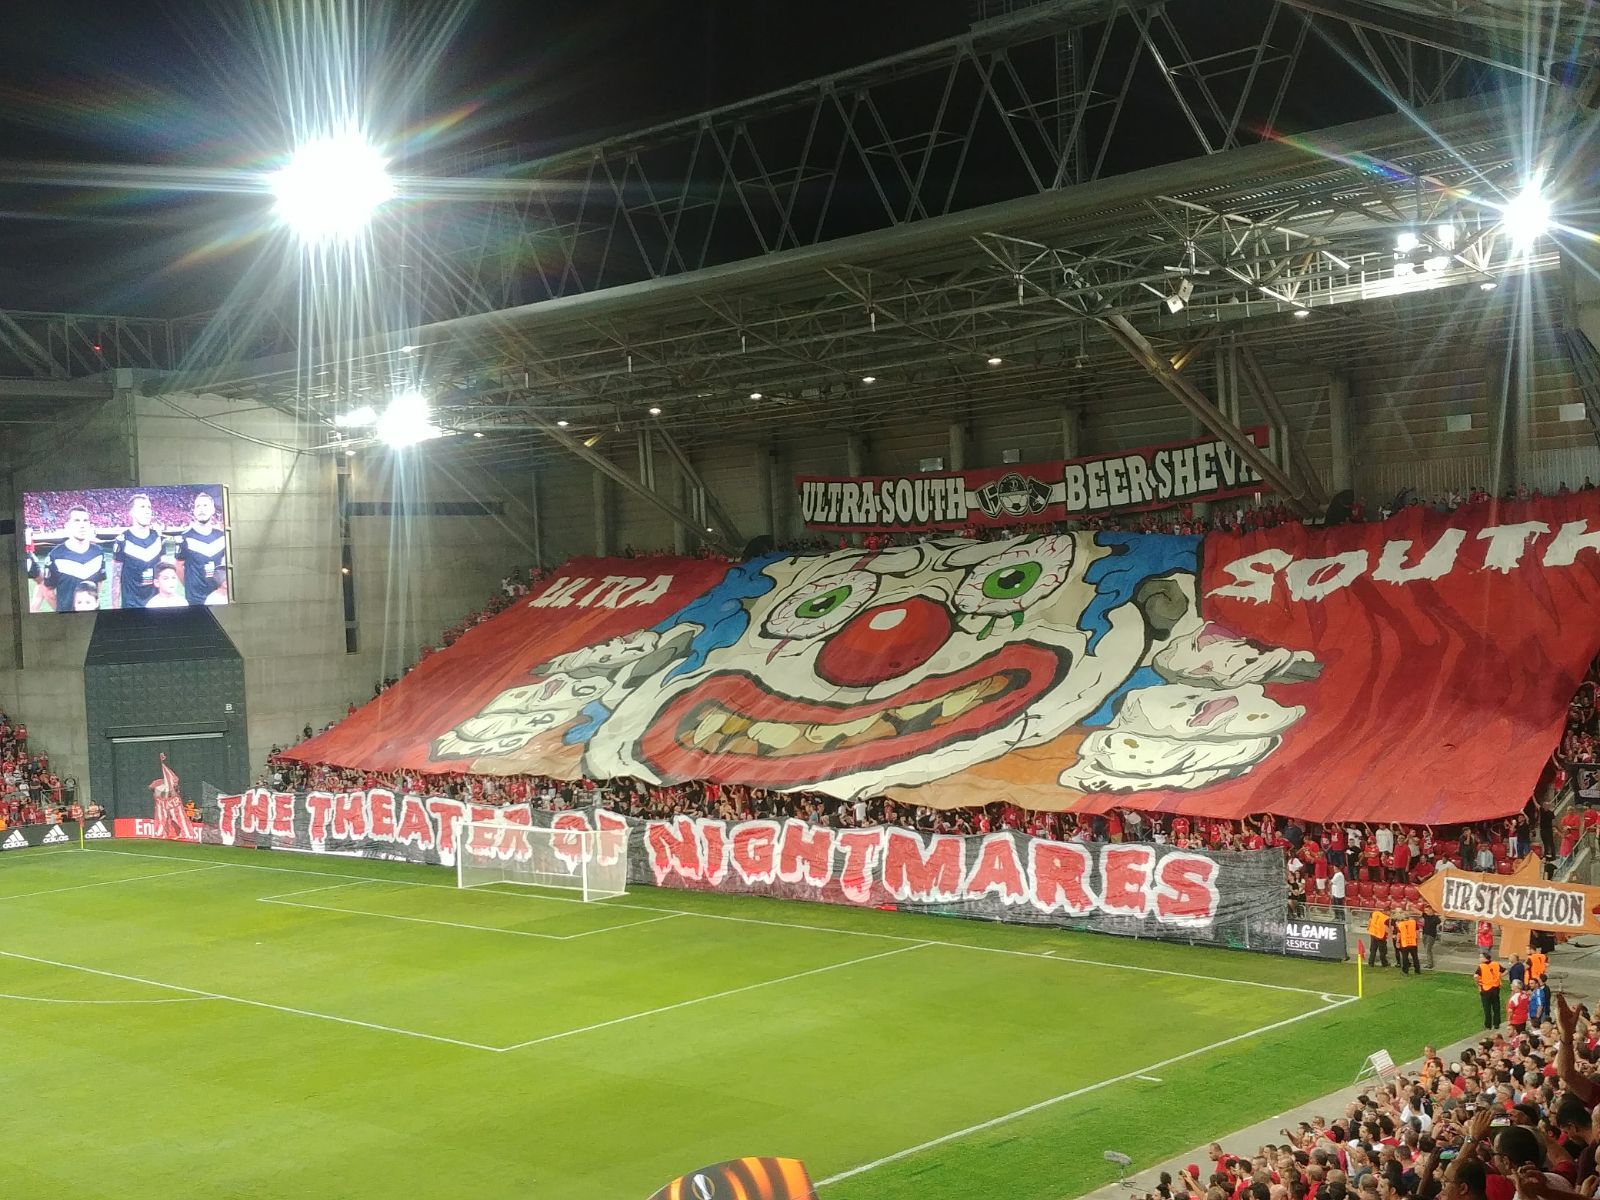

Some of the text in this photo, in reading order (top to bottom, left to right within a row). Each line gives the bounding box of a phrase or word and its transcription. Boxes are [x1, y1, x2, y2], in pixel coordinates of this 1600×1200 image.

[802, 481, 878, 523] ULTRA
[881, 478, 968, 523] SOUTH
[1065, 455, 1153, 511] BEER
[528, 575, 675, 609] ULTRA
[217, 788, 297, 846] THE
[305, 788, 533, 867] THEATER
[644, 814, 1219, 927] NIGHTMARES
[1443, 878, 1584, 926] FIRST STATION
